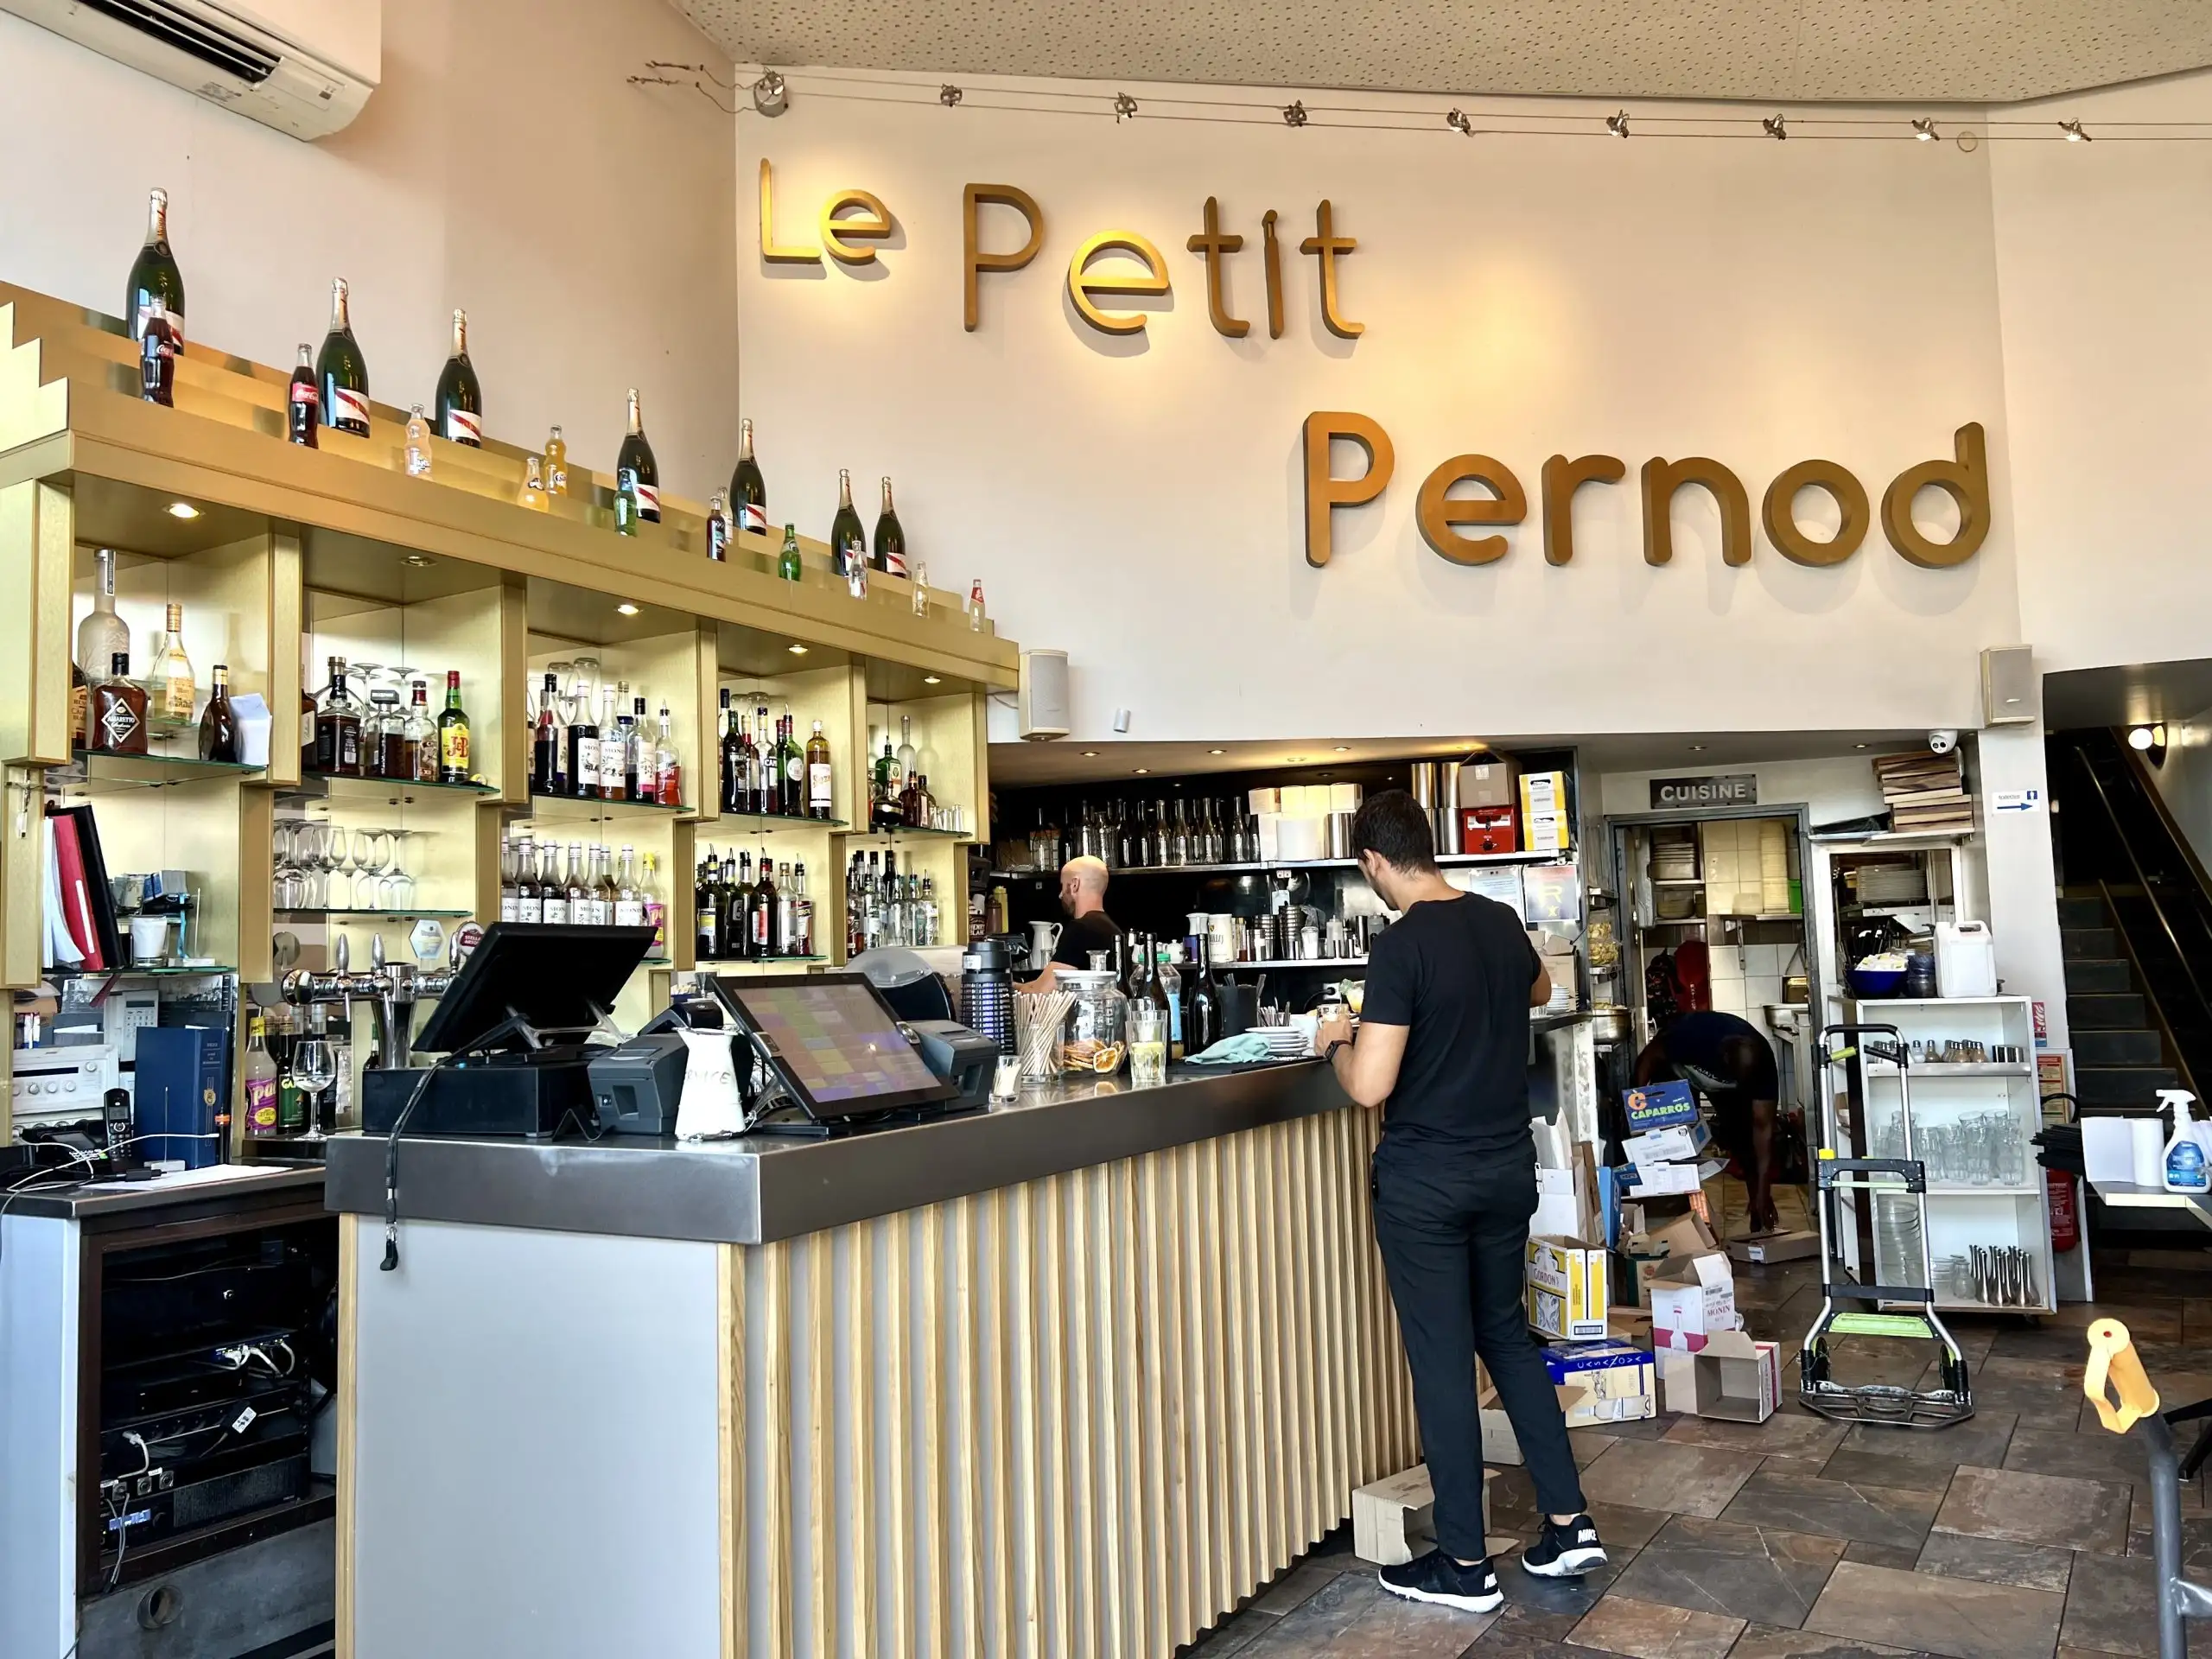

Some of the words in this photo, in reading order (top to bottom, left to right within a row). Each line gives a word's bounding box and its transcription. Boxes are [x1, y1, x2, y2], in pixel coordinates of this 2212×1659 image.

[760, 158, 891, 265] Le
[964, 183, 1365, 339] Petit
[1303, 411, 1991, 568] Pernod
[1660, 783, 1746, 802] CUISINE
[1707, 1306, 1731, 1317] MONIN
[1578, 1529, 1598, 1543] NIKE
